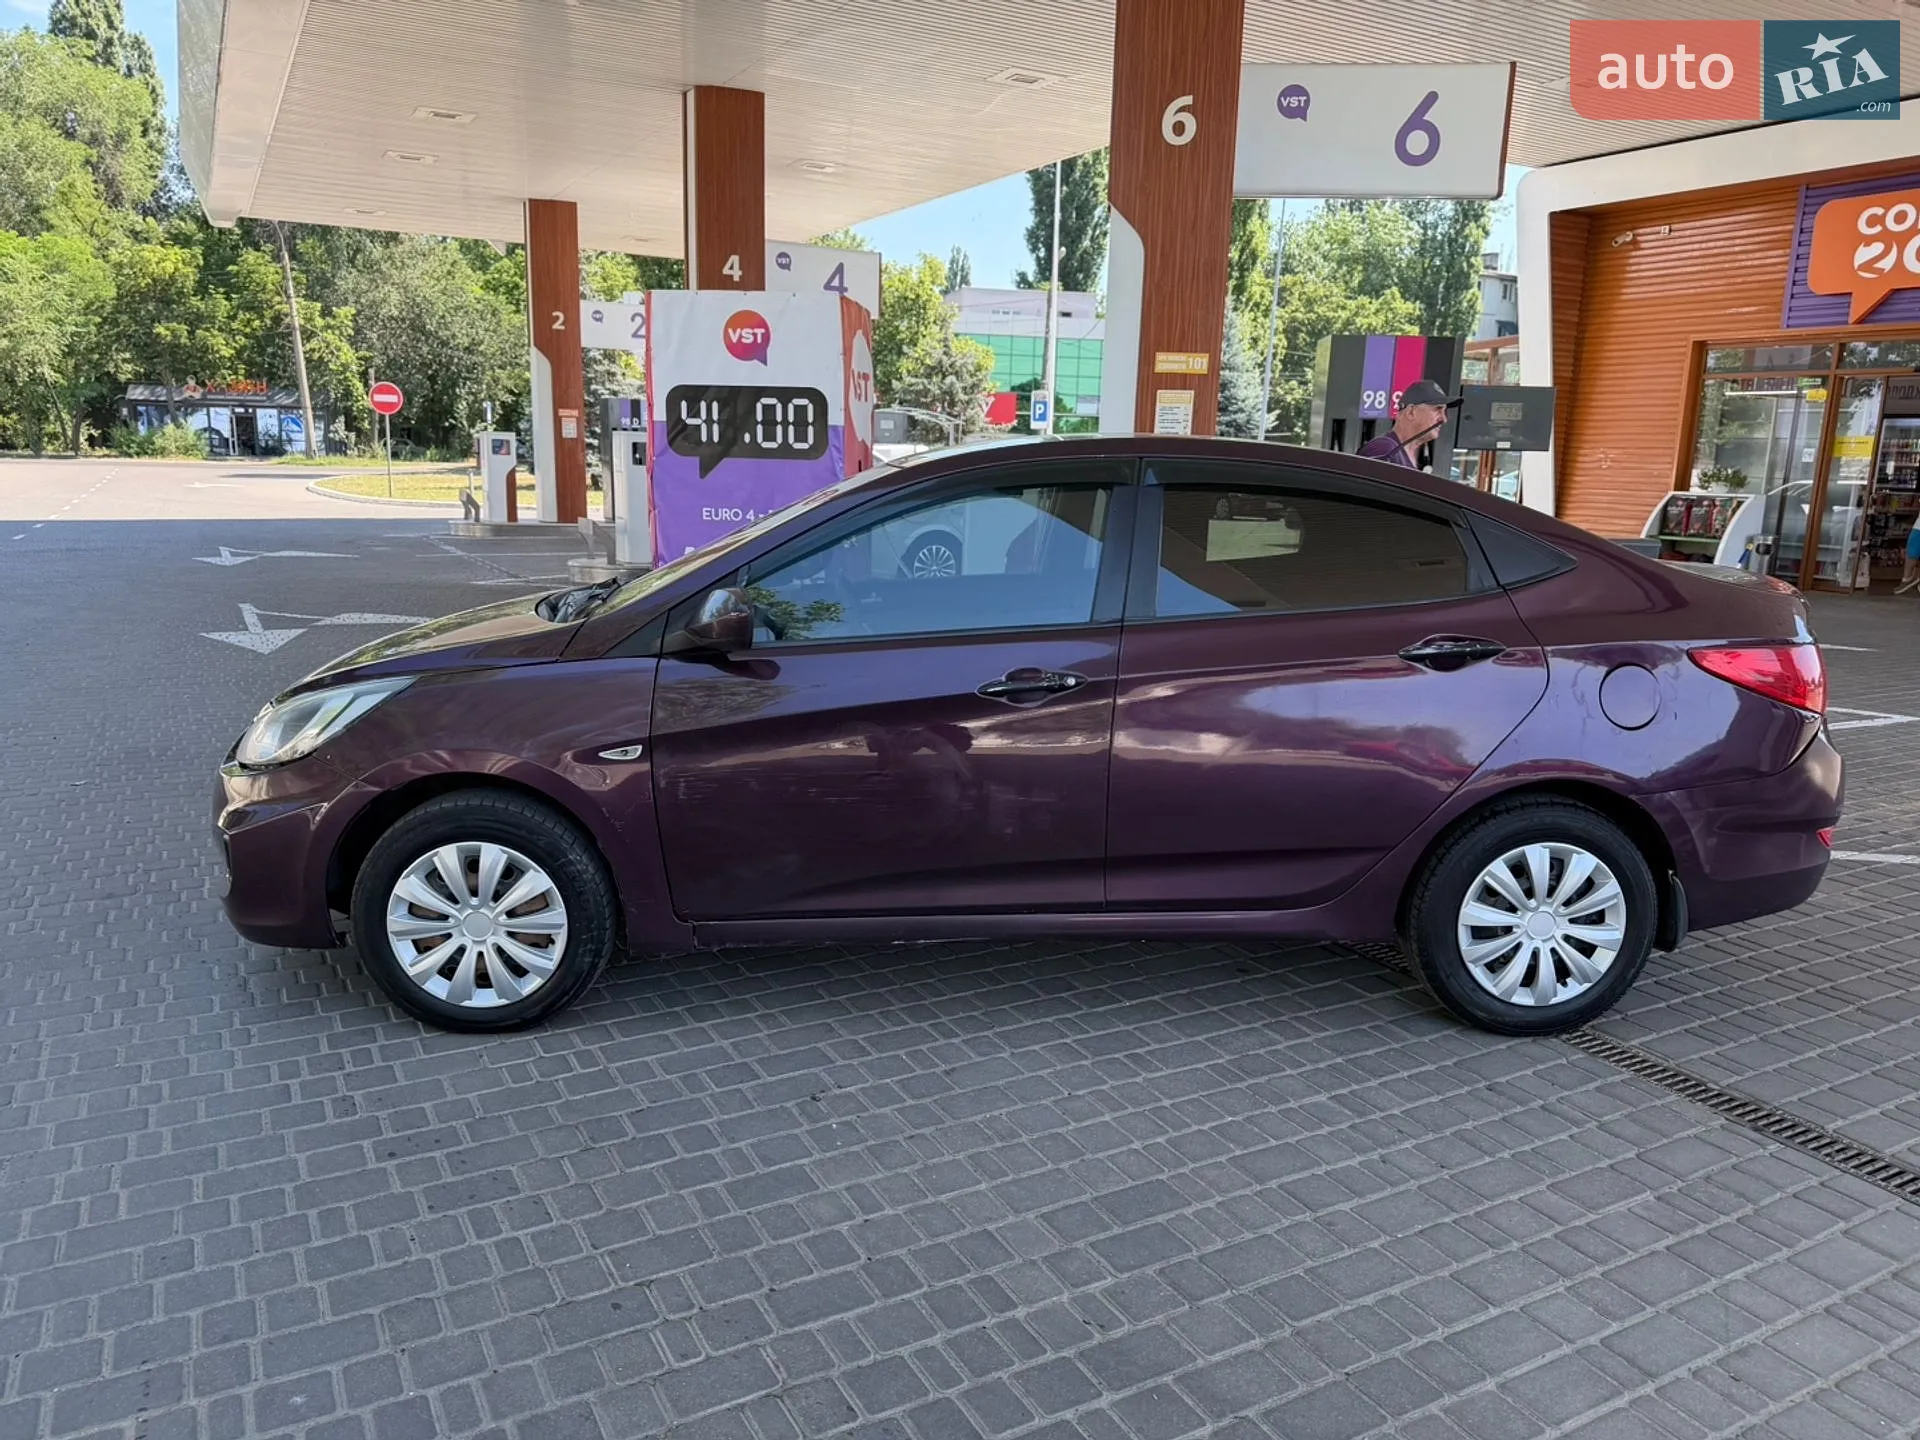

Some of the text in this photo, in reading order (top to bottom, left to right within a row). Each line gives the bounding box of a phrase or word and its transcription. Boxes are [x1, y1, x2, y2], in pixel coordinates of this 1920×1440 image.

[1160, 94, 1198, 146] 6
[1280, 90, 1441, 167] VST 6
[1857, 203, 1920, 235] CO
[722, 254, 743, 282] 4
[823, 262, 849, 295] 4
[551, 311, 566, 330] 2
[631, 312, 646, 339] 2
[727, 328, 766, 344] VST
[1034, 403, 1045, 420] P
[1362, 390, 1387, 410] 98
[702, 507, 742, 522] EURO
[745, 508, 755, 522] 4
